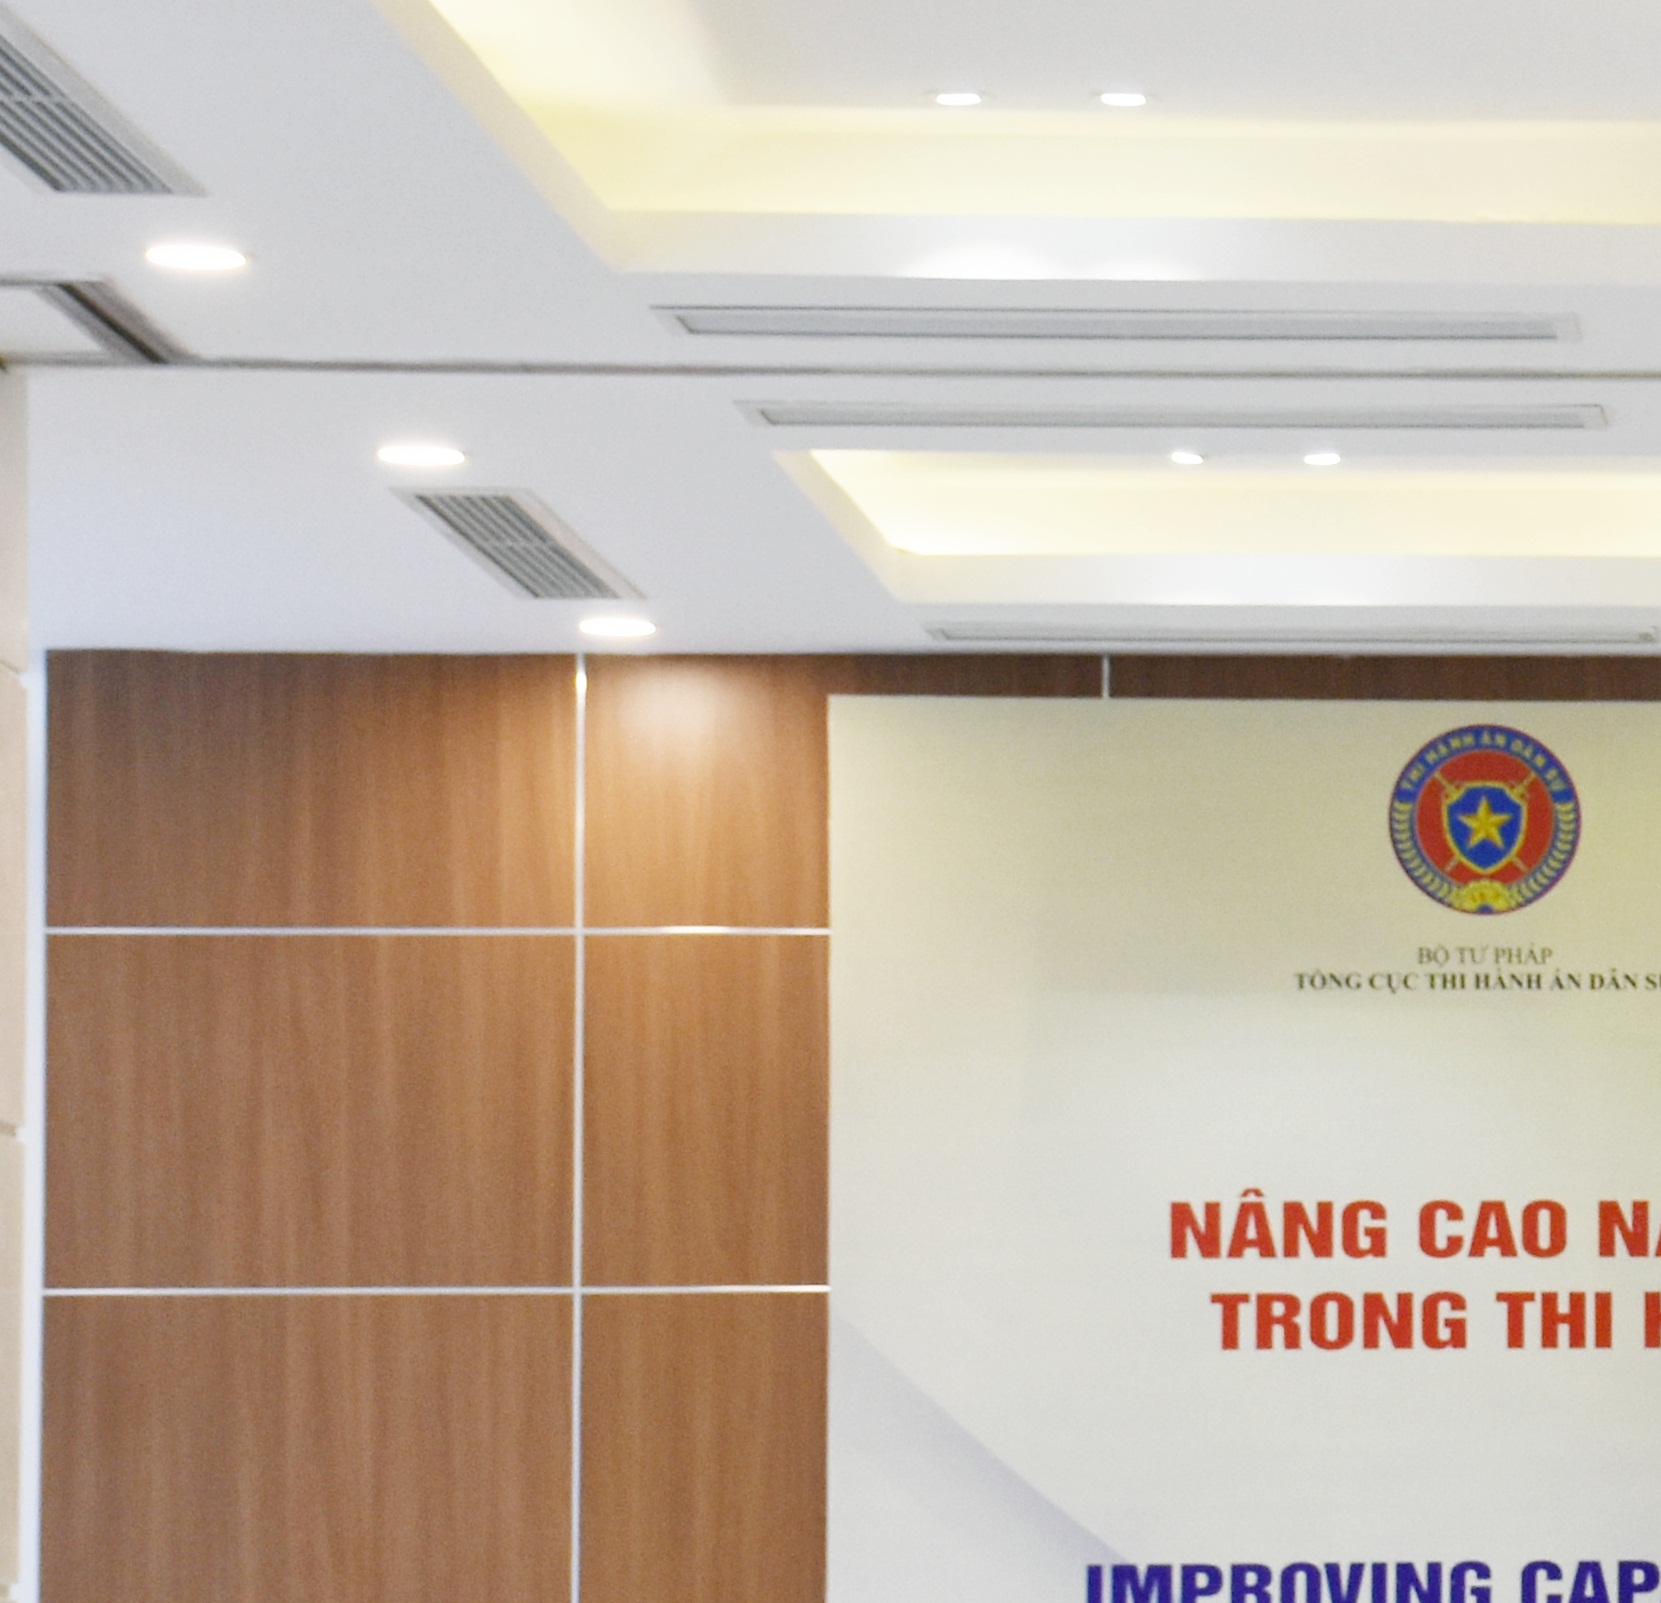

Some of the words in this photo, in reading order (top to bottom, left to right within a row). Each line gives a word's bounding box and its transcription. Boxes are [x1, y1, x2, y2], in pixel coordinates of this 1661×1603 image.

[1368, 972, 1419, 995] CỤC
[1424, 972, 1466, 991] THI
[1475, 967, 1542, 991] HÀNH
[1170, 1189, 1387, 1259] NÂNG
[1419, 1200, 1567, 1258] CAO
[1210, 1291, 1467, 1350] TRONG
[1496, 1292, 1612, 1350] THI
